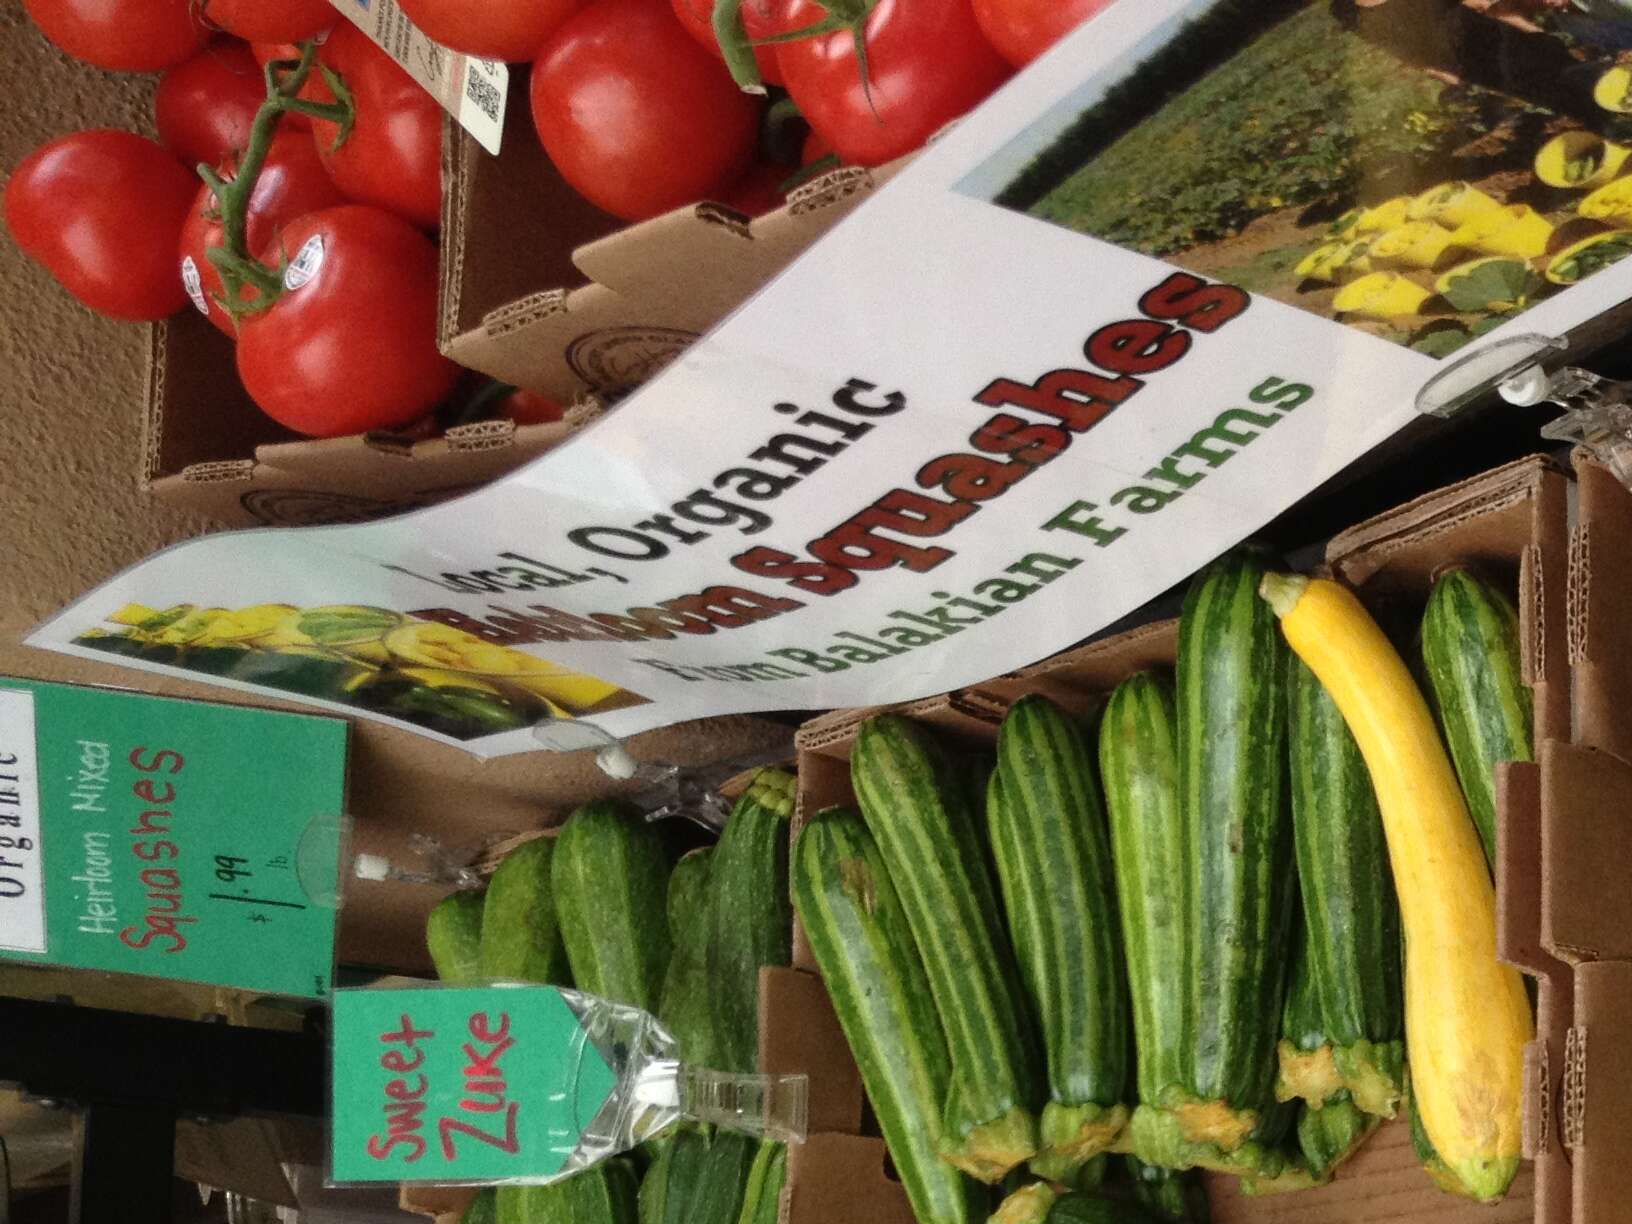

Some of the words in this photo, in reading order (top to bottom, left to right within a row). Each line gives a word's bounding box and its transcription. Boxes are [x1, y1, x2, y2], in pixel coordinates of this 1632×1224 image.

[567, 377, 907, 562] Organic
[628, 657, 808, 683] From
[766, 549, 1084, 673] Balakian
[1040, 376, 1316, 548] Farms
[729, 271, 1253, 596] Squashes
[71, 831, 118, 934] Heirloom
[119, 746, 198, 954] Squashes
[367, 1013, 435, 1164] Sweet
